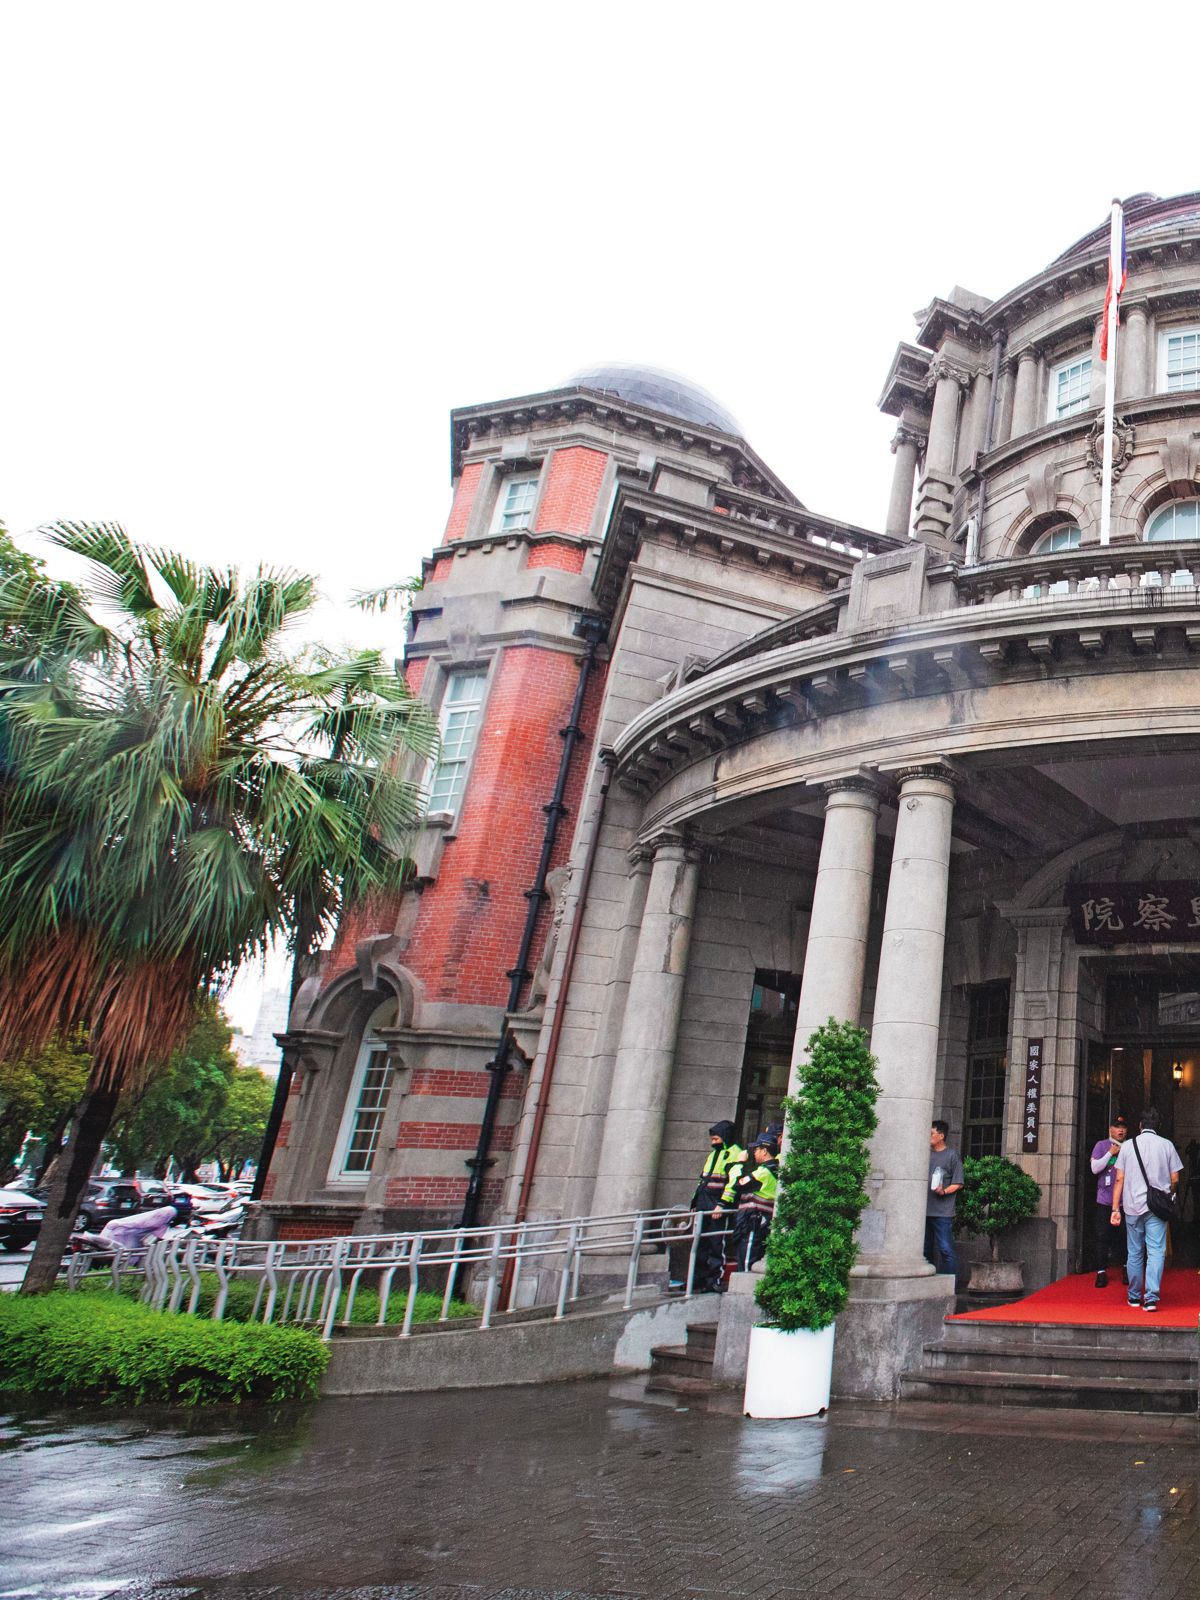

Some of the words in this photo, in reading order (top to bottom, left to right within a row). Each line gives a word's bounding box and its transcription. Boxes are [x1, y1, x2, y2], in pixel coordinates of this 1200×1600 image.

[1023, 1045, 1040, 1143] 國家人權委員會
